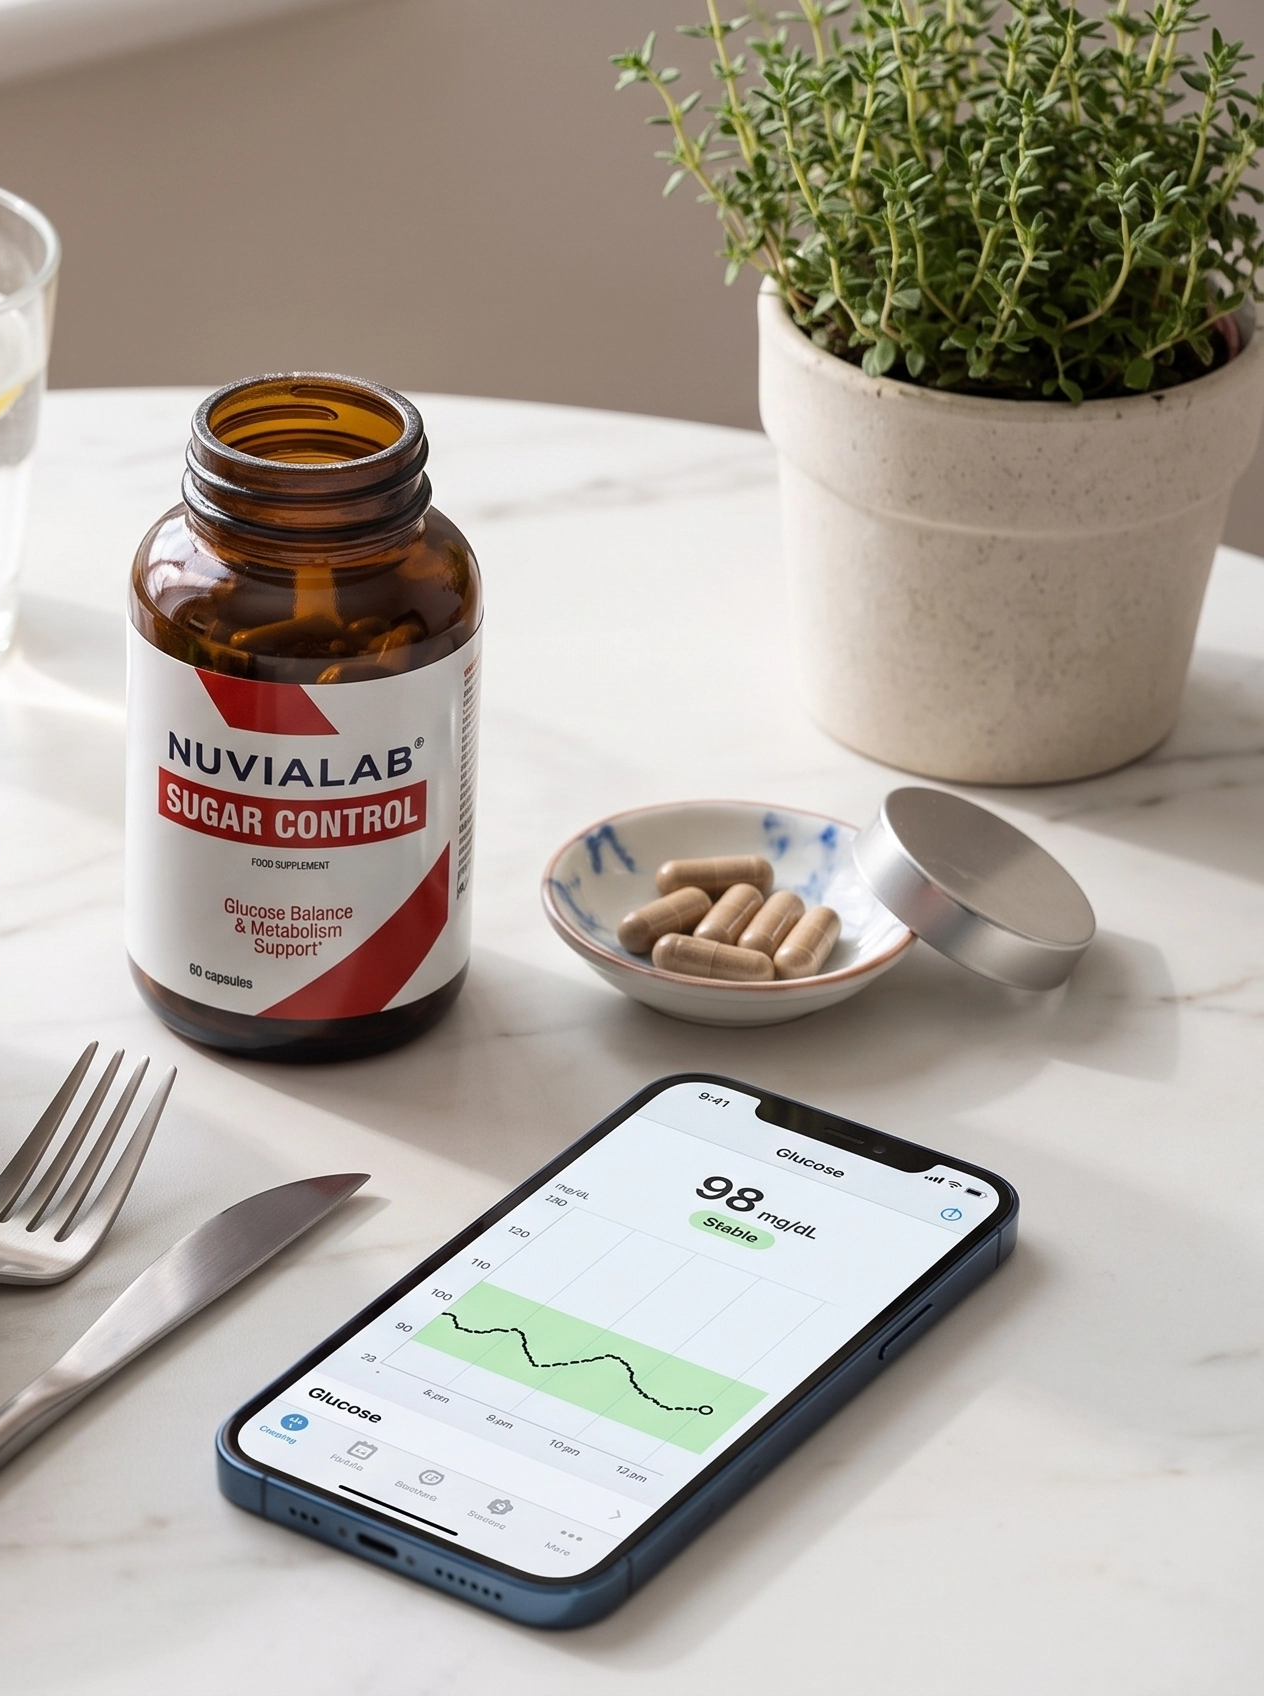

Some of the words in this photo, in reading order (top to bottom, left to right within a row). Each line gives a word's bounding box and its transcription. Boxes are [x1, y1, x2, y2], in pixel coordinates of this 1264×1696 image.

[166, 783, 262, 836] SUGAR
[275, 796, 418, 839] CONTROL
[251, 857, 274, 869] FOOD
[275, 860, 330, 870] SUPPLEMENT
[224, 898, 286, 921] Glucose
[290, 905, 353, 921] Balance
[234, 917, 246, 934] &
[251, 920, 342, 938] Metabolism
[189, 963, 202, 977] 60
[205, 969, 253, 989] capsules
[698, 1092, 730, 1108] 9:41
[776, 1147, 845, 1179] Glucose
[695, 1175, 764, 1213] 98
[757, 1210, 817, 1240] mg/dL
[508, 1225, 530, 1238] 120
[703, 1216, 758, 1243] Stable
[471, 1258, 491, 1270] 110
[431, 1288, 453, 1301] 100
[395, 1322, 413, 1333] 90
[308, 1387, 382, 1424] Glucose
